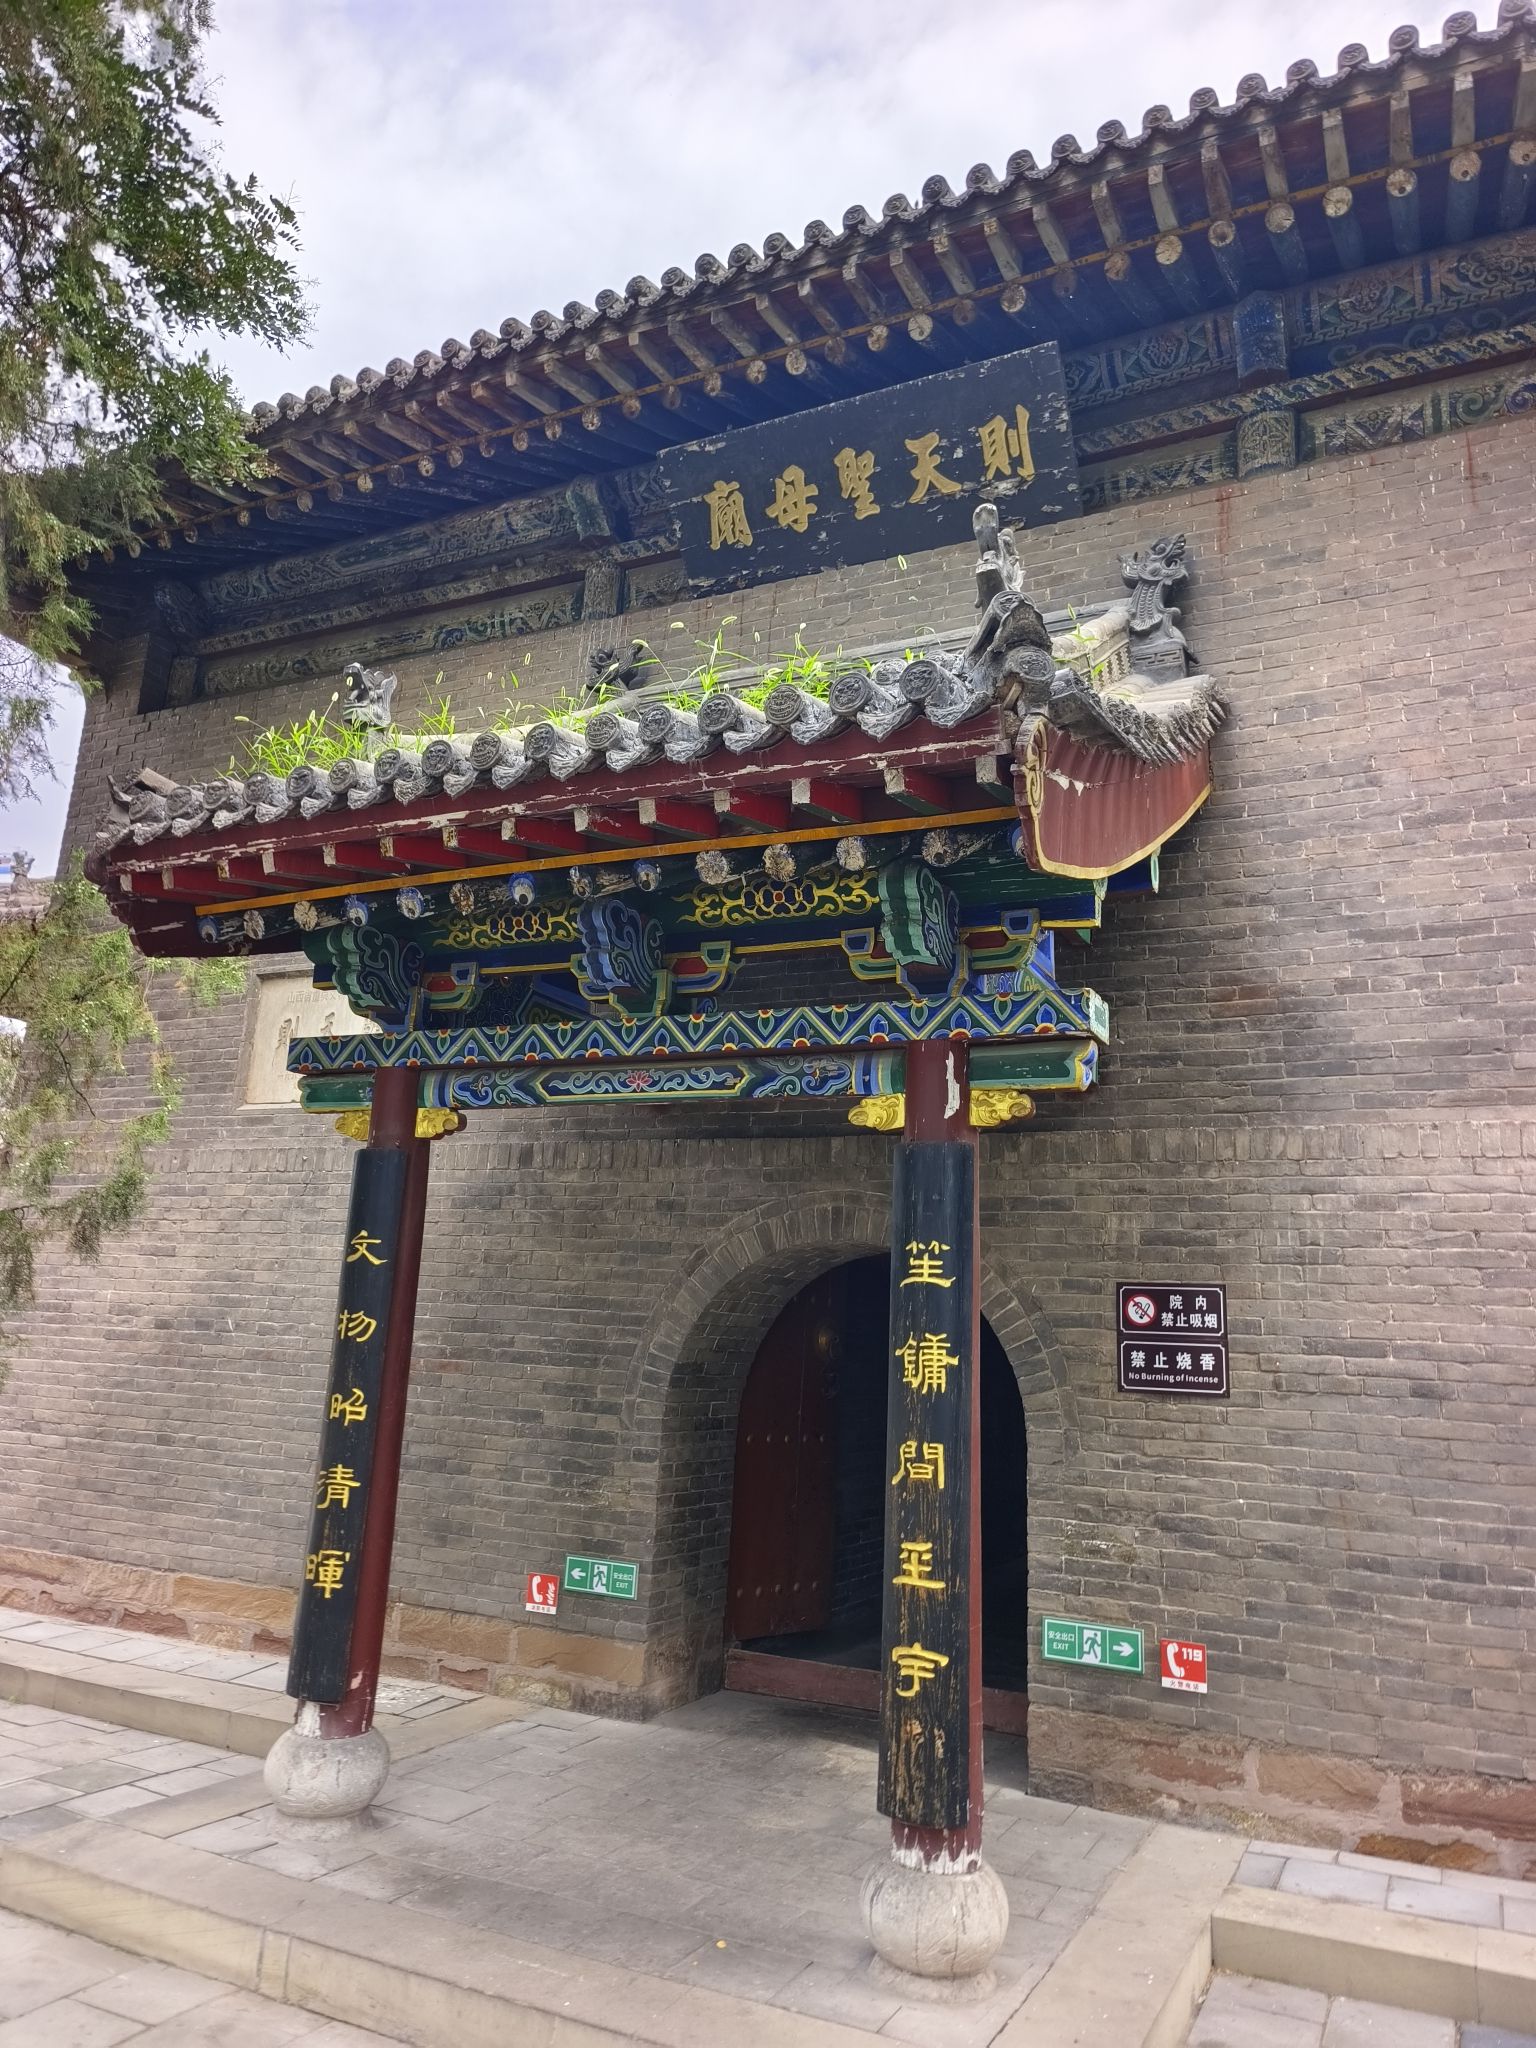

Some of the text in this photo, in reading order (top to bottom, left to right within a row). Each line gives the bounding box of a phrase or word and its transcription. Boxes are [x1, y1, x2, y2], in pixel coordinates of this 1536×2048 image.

[1169, 1294, 1207, 1311] 院内
[1161, 1312, 1218, 1329] 禁止吸烟
[1130, 1350, 1216, 1371] 禁止烧香
[1128, 1372, 1219, 1384] No Burning of Incense
[1047, 1630, 1075, 1643] 安全出口
[1052, 1642, 1069, 1651] EXIT
[1181, 1647, 1203, 1662] 119
